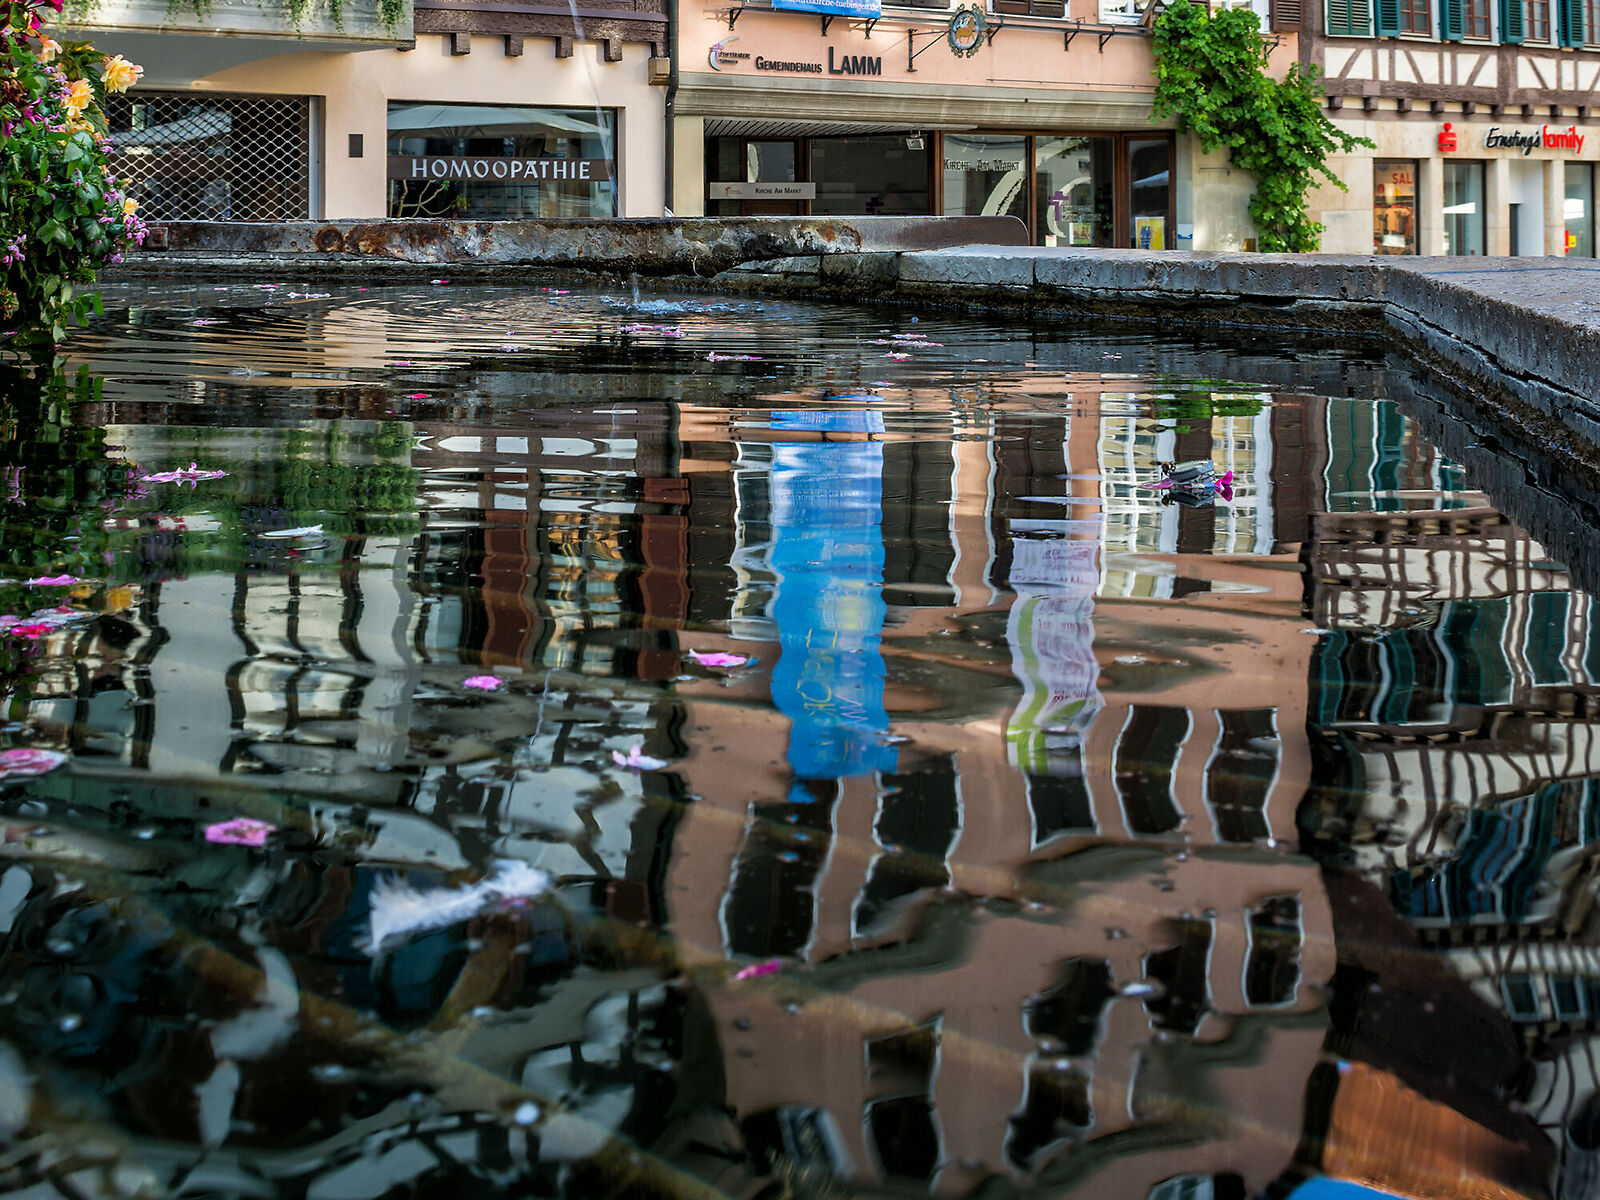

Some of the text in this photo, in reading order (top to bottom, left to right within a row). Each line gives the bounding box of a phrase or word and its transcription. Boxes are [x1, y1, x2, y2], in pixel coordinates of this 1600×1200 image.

[755, 46, 882, 76] GEMEINDEHAUS LAMM
[1486, 124, 1585, 156] Ernsting's family
[411, 158, 592, 180] HOMÖOPATHIE
